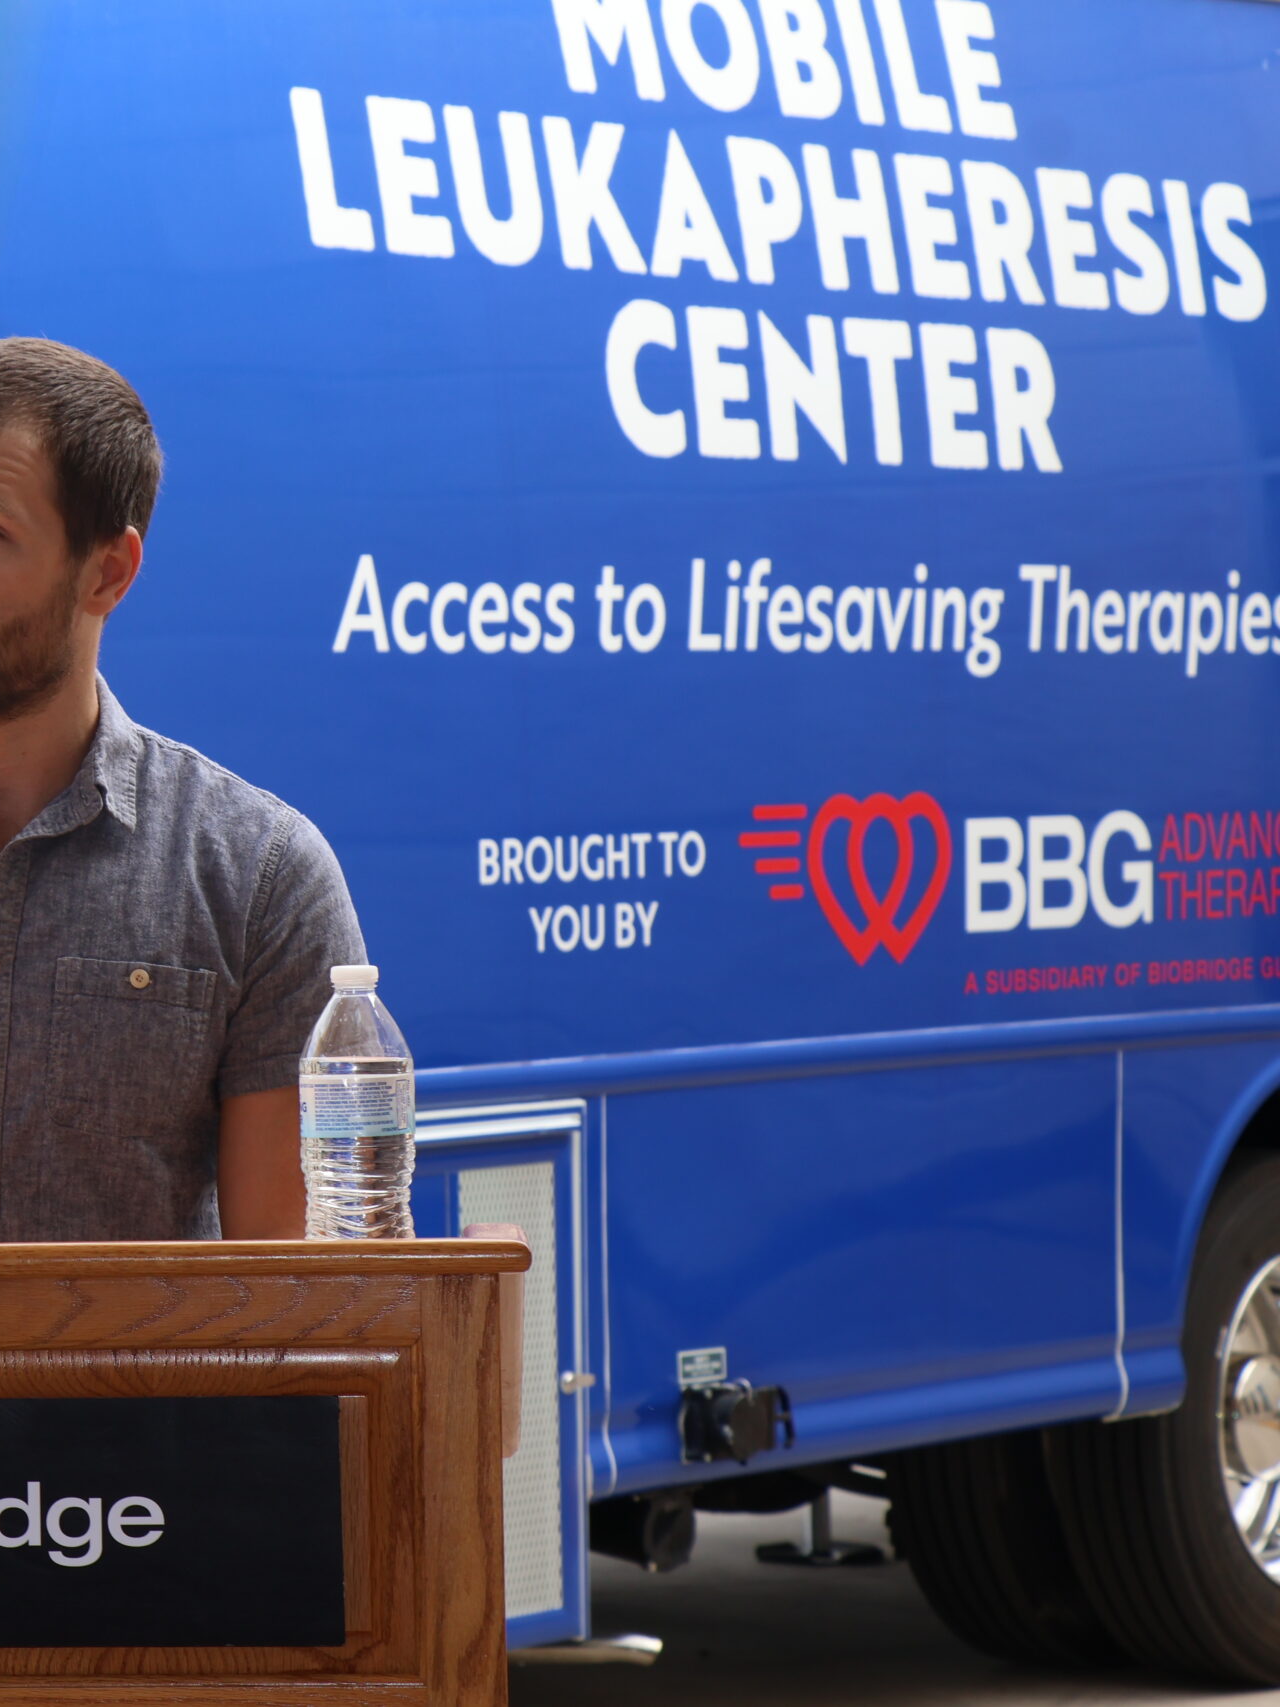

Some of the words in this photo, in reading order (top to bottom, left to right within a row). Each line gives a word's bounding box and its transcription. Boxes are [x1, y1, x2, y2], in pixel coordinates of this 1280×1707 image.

[551, 0, 1018, 141] MOBILE
[289, 86, 1267, 322] LEUKAPHERESIS
[605, 298, 1063, 473] CENTER
[332, 553, 575, 654] Access
[595, 565, 667, 654] to
[687, 557, 1005, 678] Lifesaving
[1019, 564, 1280, 678] Therapie
[478, 832, 653, 886] BROUGHT
[657, 830, 707, 877] TO
[965, 810, 1154, 933] BBG
[528, 903, 606, 953] YOU
[614, 901, 659, 949] BY
[963, 971, 980, 995] A
[984, 964, 1109, 995] SUBSIDIARY
[1114, 961, 1142, 988] OF
[1147, 956, 1254, 986] BIOBRIDGE
